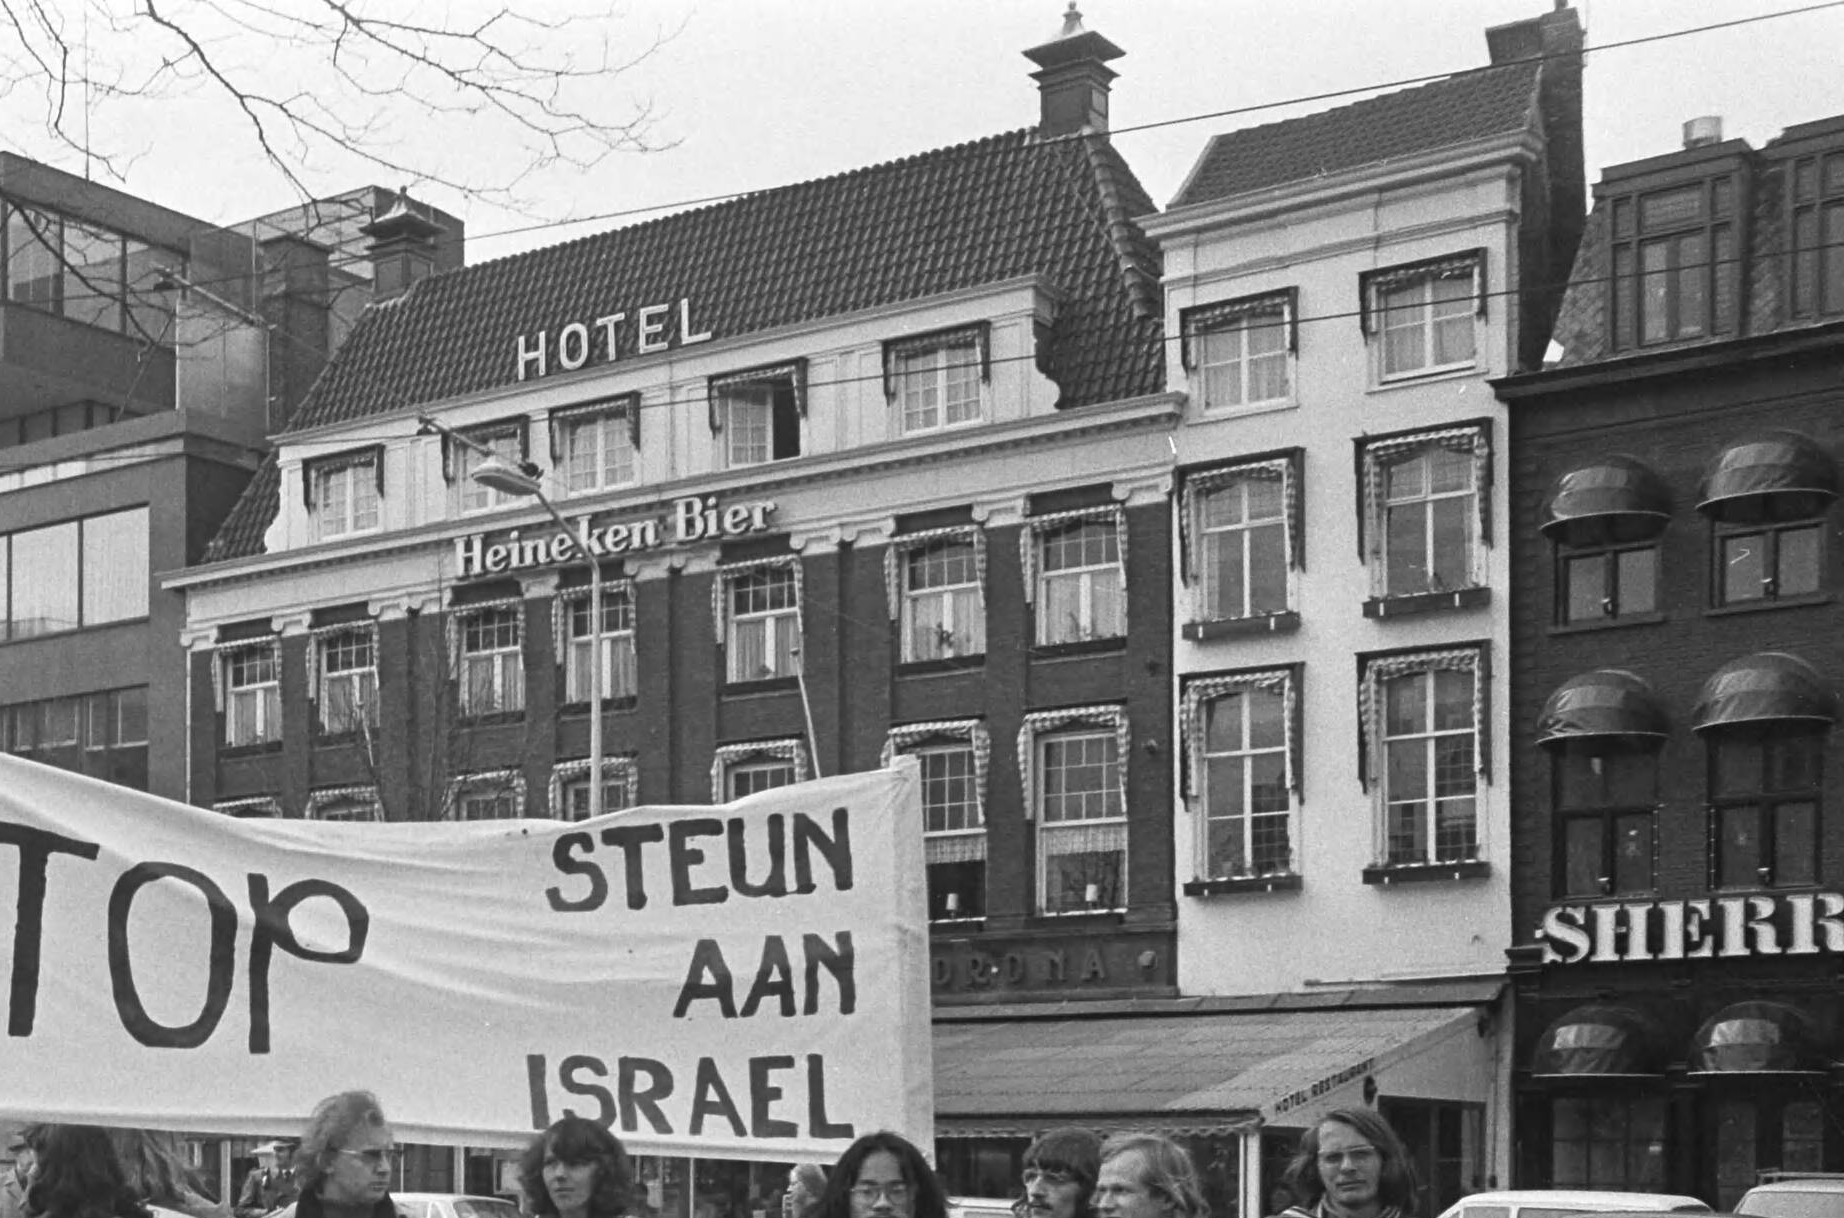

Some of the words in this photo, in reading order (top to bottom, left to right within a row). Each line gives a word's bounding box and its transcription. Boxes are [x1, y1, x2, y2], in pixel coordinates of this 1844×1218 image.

[518, 298, 712, 380] HOTEL
[453, 515, 660, 577] Heineken
[674, 496, 778, 541] Bier
[548, 808, 853, 912] STEUN
[672, 930, 855, 1018] AAN
[526, 1053, 854, 1140] ISRAEL
